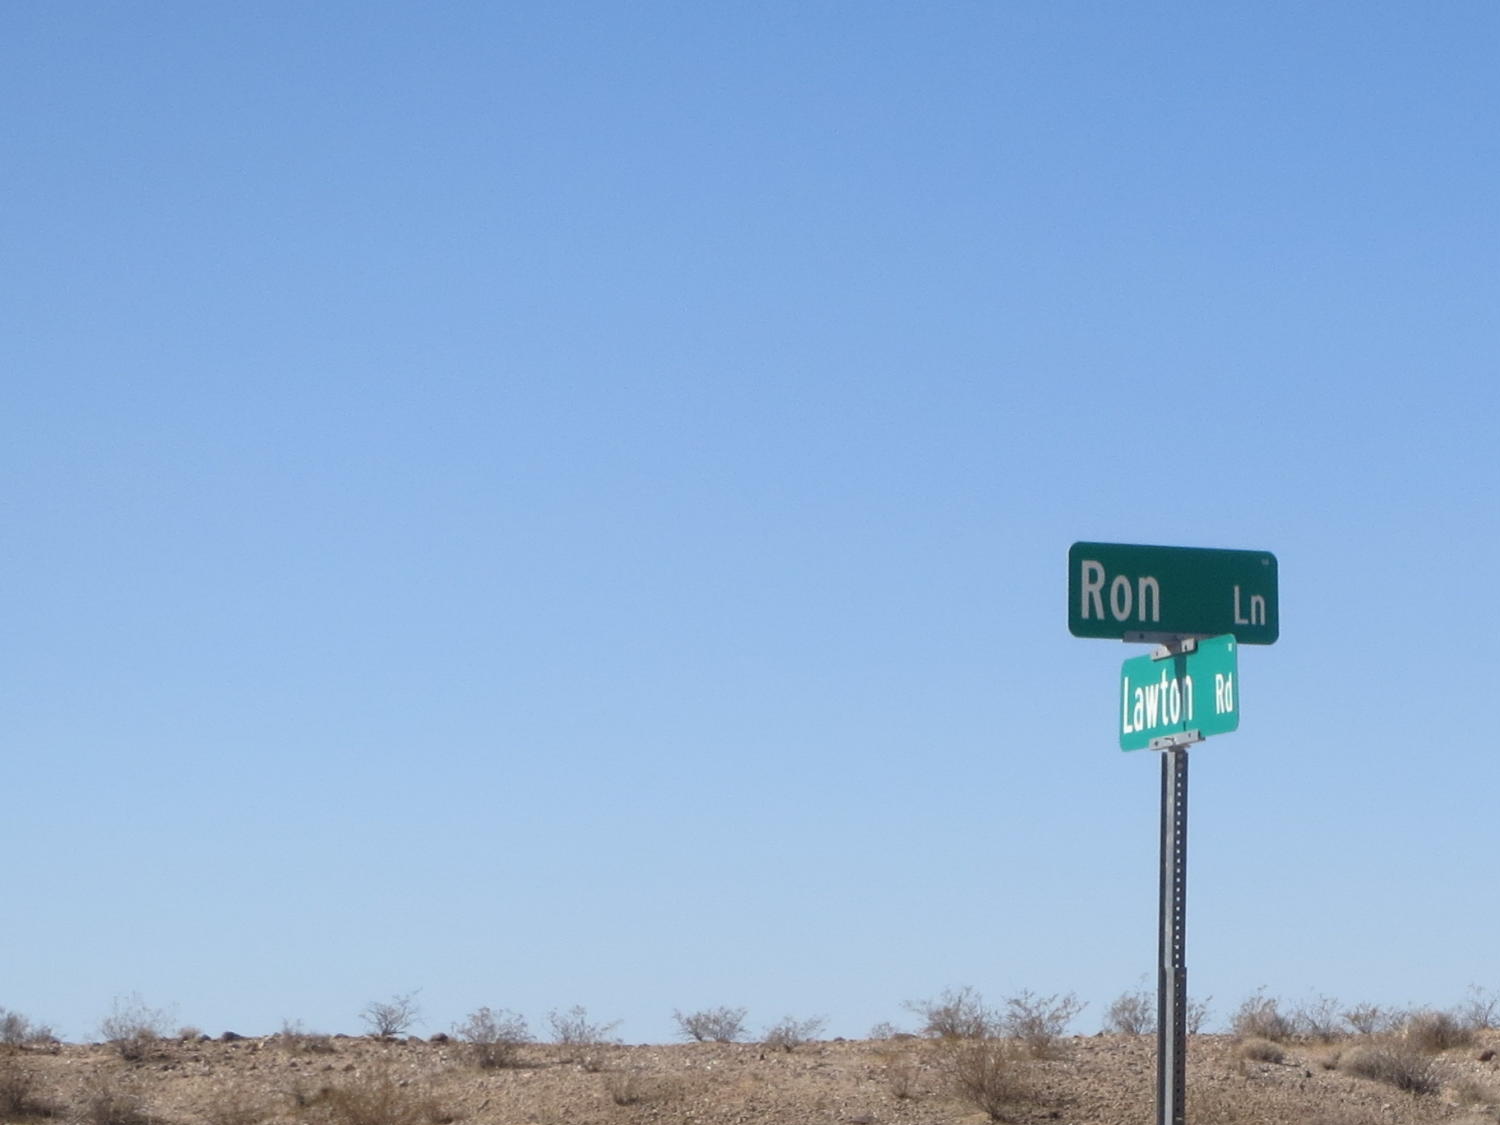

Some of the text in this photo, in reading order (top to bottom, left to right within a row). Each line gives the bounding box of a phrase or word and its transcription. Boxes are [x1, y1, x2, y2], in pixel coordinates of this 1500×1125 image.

[1081, 559, 1266, 626] Ron Ln
[1123, 668, 1233, 734] Lawton Rd
